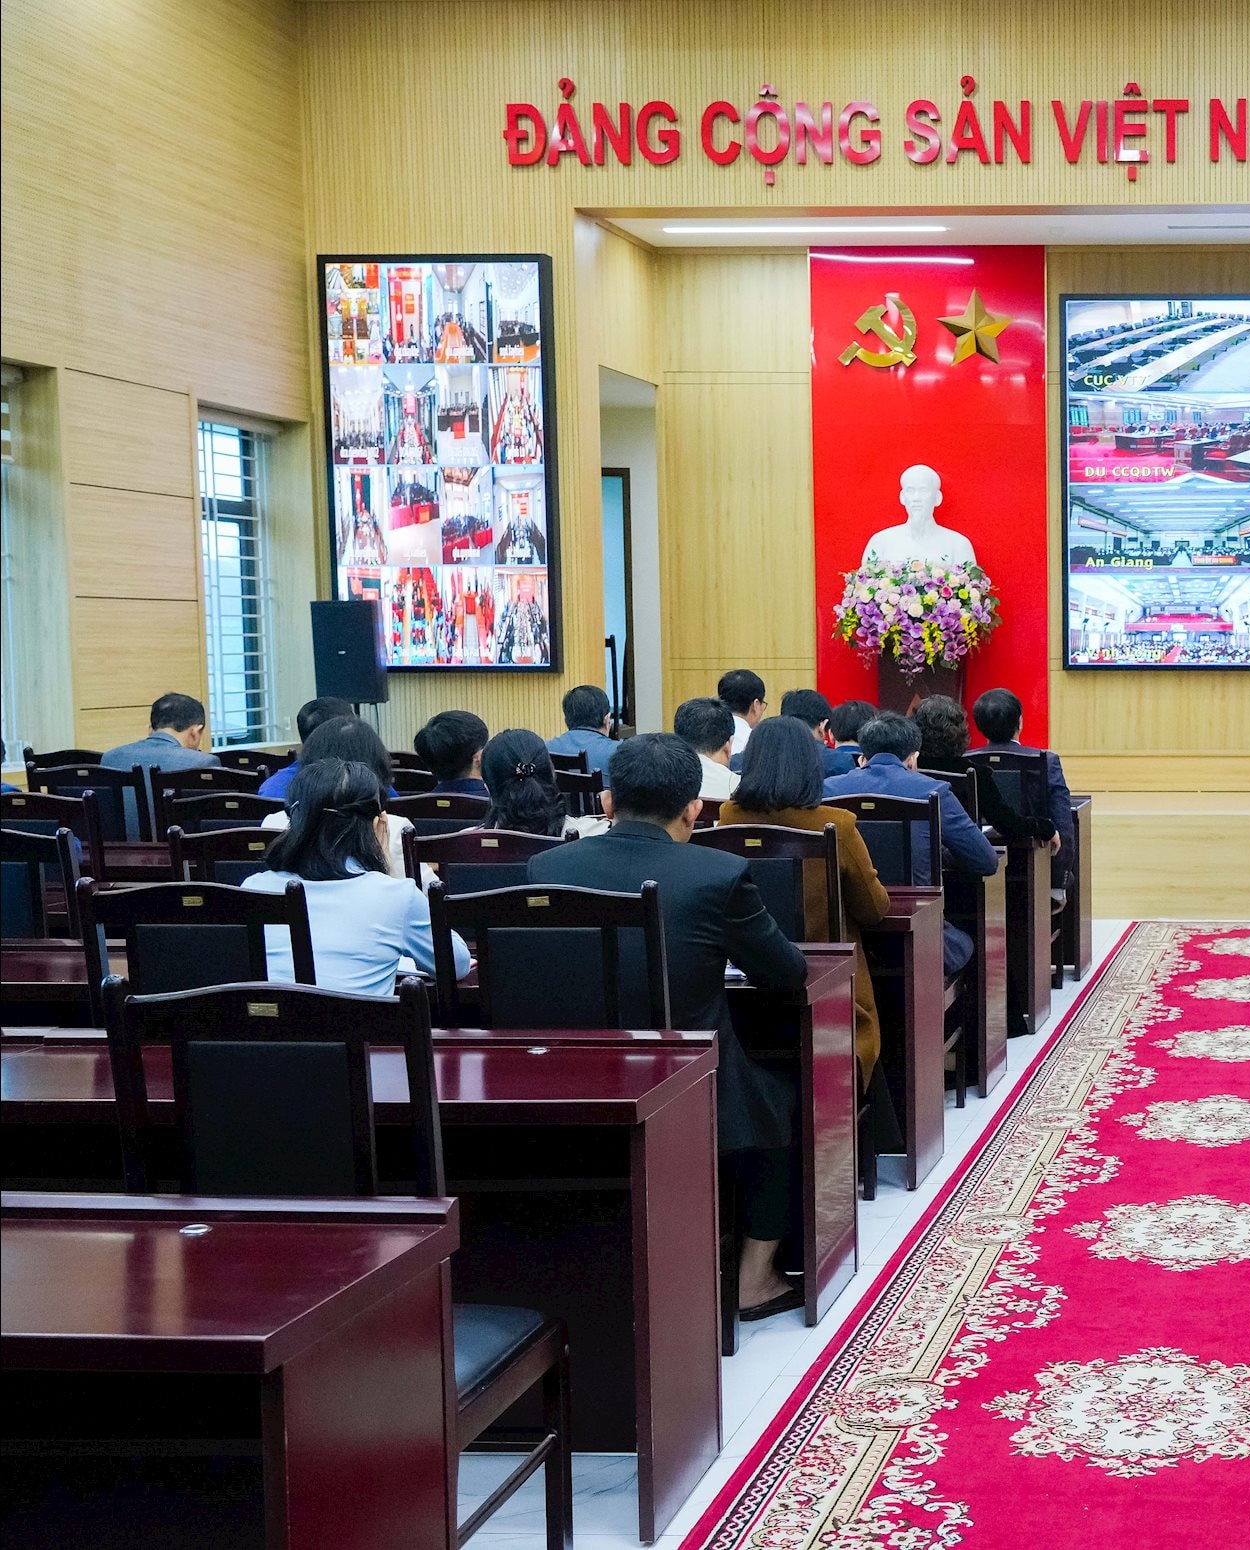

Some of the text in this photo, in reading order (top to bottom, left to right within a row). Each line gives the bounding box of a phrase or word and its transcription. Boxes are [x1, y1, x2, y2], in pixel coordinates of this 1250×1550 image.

[502, 77, 681, 166] ĐẢNG
[699, 83, 882, 185] CỘNG
[903, 75, 1031, 165] SẢN
[1051, 82, 1190, 181] VIỆT
[1085, 556, 1154, 570] An Giang
